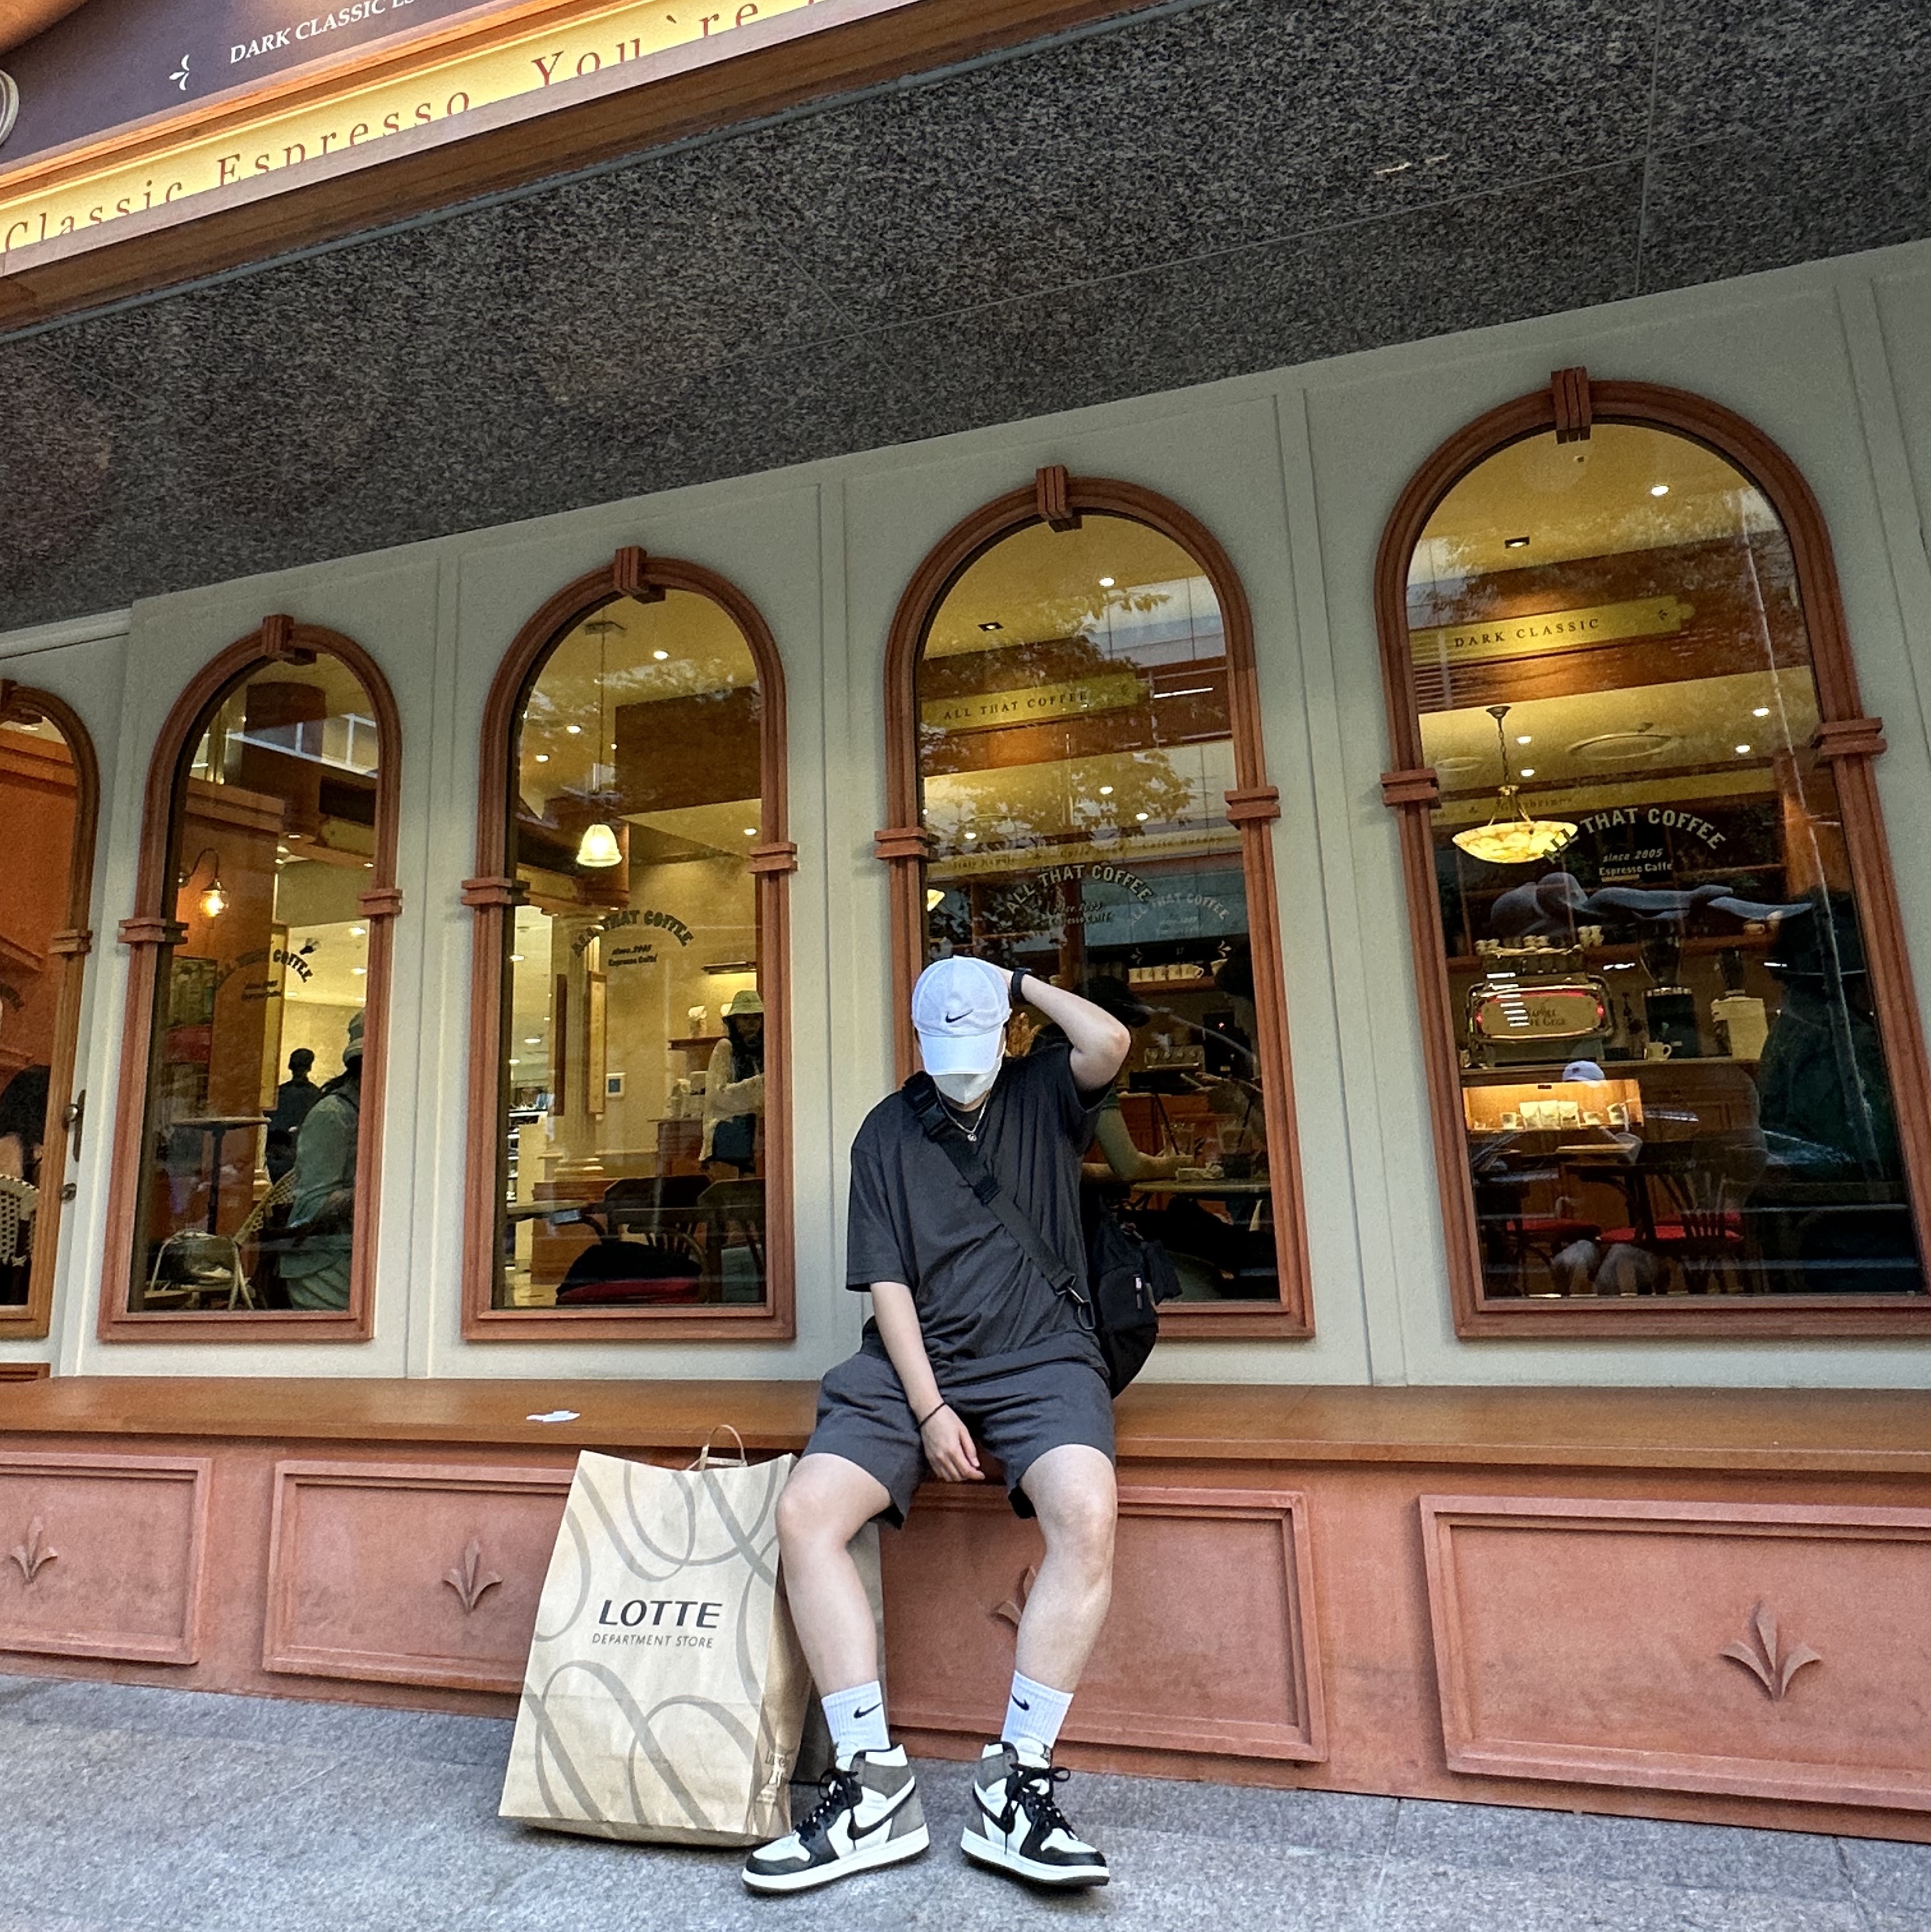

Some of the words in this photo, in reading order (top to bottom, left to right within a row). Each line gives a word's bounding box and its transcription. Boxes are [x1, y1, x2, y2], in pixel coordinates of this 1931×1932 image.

[231, 27, 291, 64] DARK
[295, 0, 386, 40] CLASSIC
[1454, 631, 1506, 648] DARK
[1516, 618, 1599, 639] CLASSIC
[943, 707, 972, 720] ALL
[979, 701, 1019, 715] THAT
[1027, 691, 1087, 709] COFFEE
[1579, 807, 1638, 834] THAT
[1647, 807, 1727, 850] COFFEE
[1603, 853, 1631, 863] since
[1635, 848, 1664, 860] 2005
[1599, 865, 1643, 877] Espresso
[1006, 883, 1036, 914] ALL
[1037, 864, 1085, 888] THAT
[1092, 864, 1154, 902] COFFEE
[599, 1599, 723, 1629] LOTTE
[592, 1632, 672, 1647] DEPARTMENT
[675, 1635, 714, 1649] STORE
